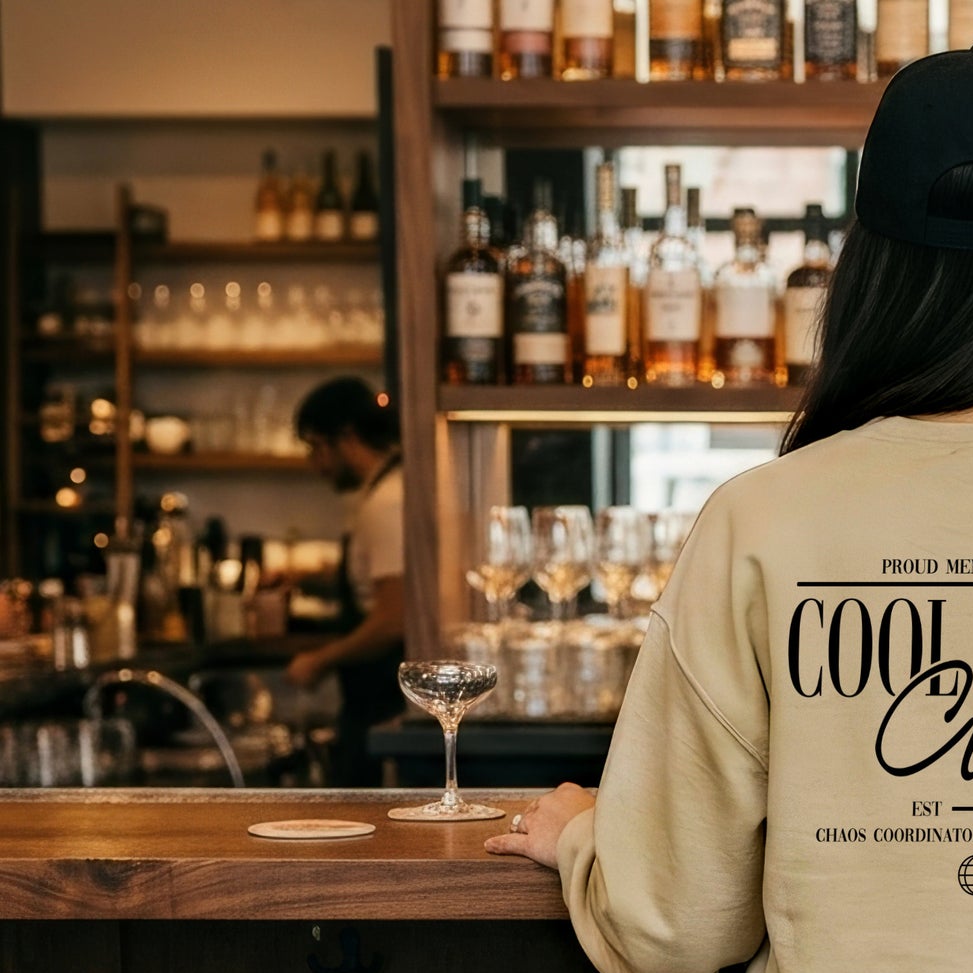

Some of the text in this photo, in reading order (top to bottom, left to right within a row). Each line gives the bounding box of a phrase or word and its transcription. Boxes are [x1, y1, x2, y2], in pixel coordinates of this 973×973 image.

[882, 558, 938, 575] PROUD
[787, 597, 960, 698] COOL
[911, 801, 943, 817] EST
[815, 827, 867, 843] CHAOS
